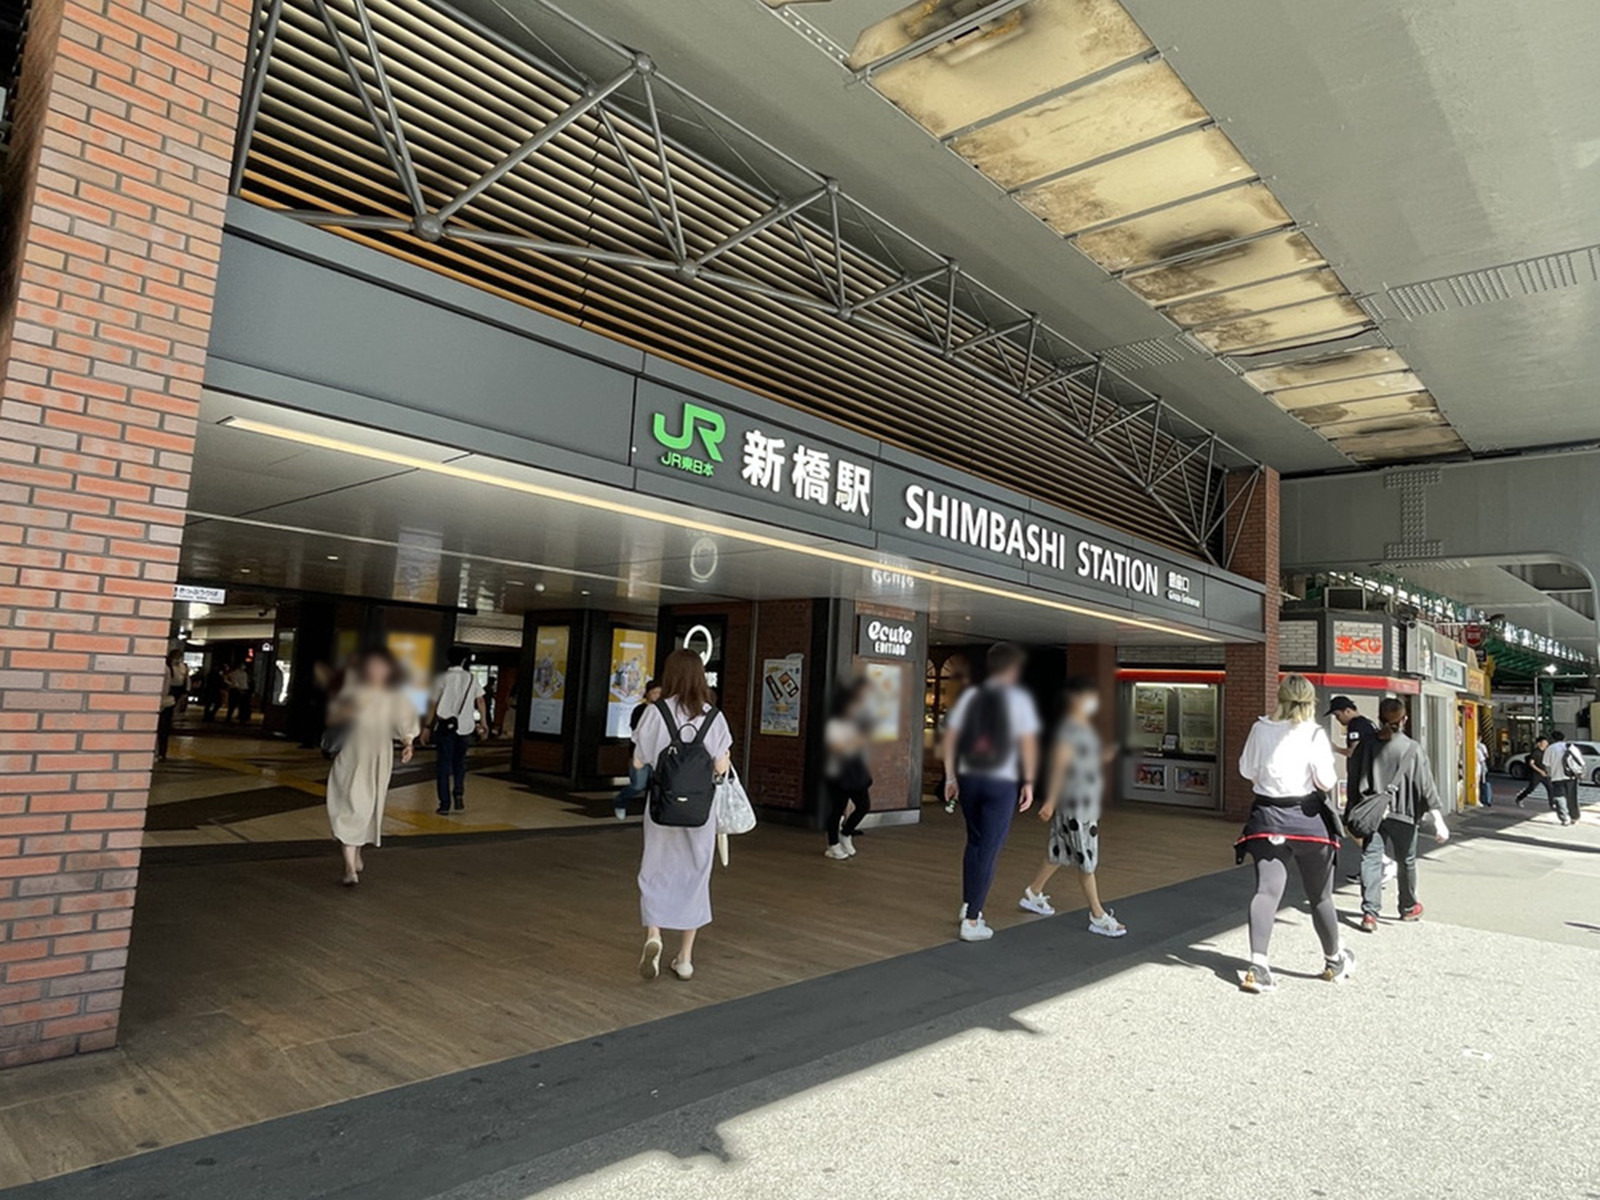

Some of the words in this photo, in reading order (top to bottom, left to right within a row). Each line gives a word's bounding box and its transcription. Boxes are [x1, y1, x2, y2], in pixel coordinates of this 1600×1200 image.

[654, 402, 725, 462] JR
[660, 450, 716, 478] JR東日本
[741, 430, 872, 517] 新橋駅
[904, 484, 1066, 571] SHIMBASHI
[1077, 541, 1159, 597] STATION
[867, 620, 914, 645] ecute
